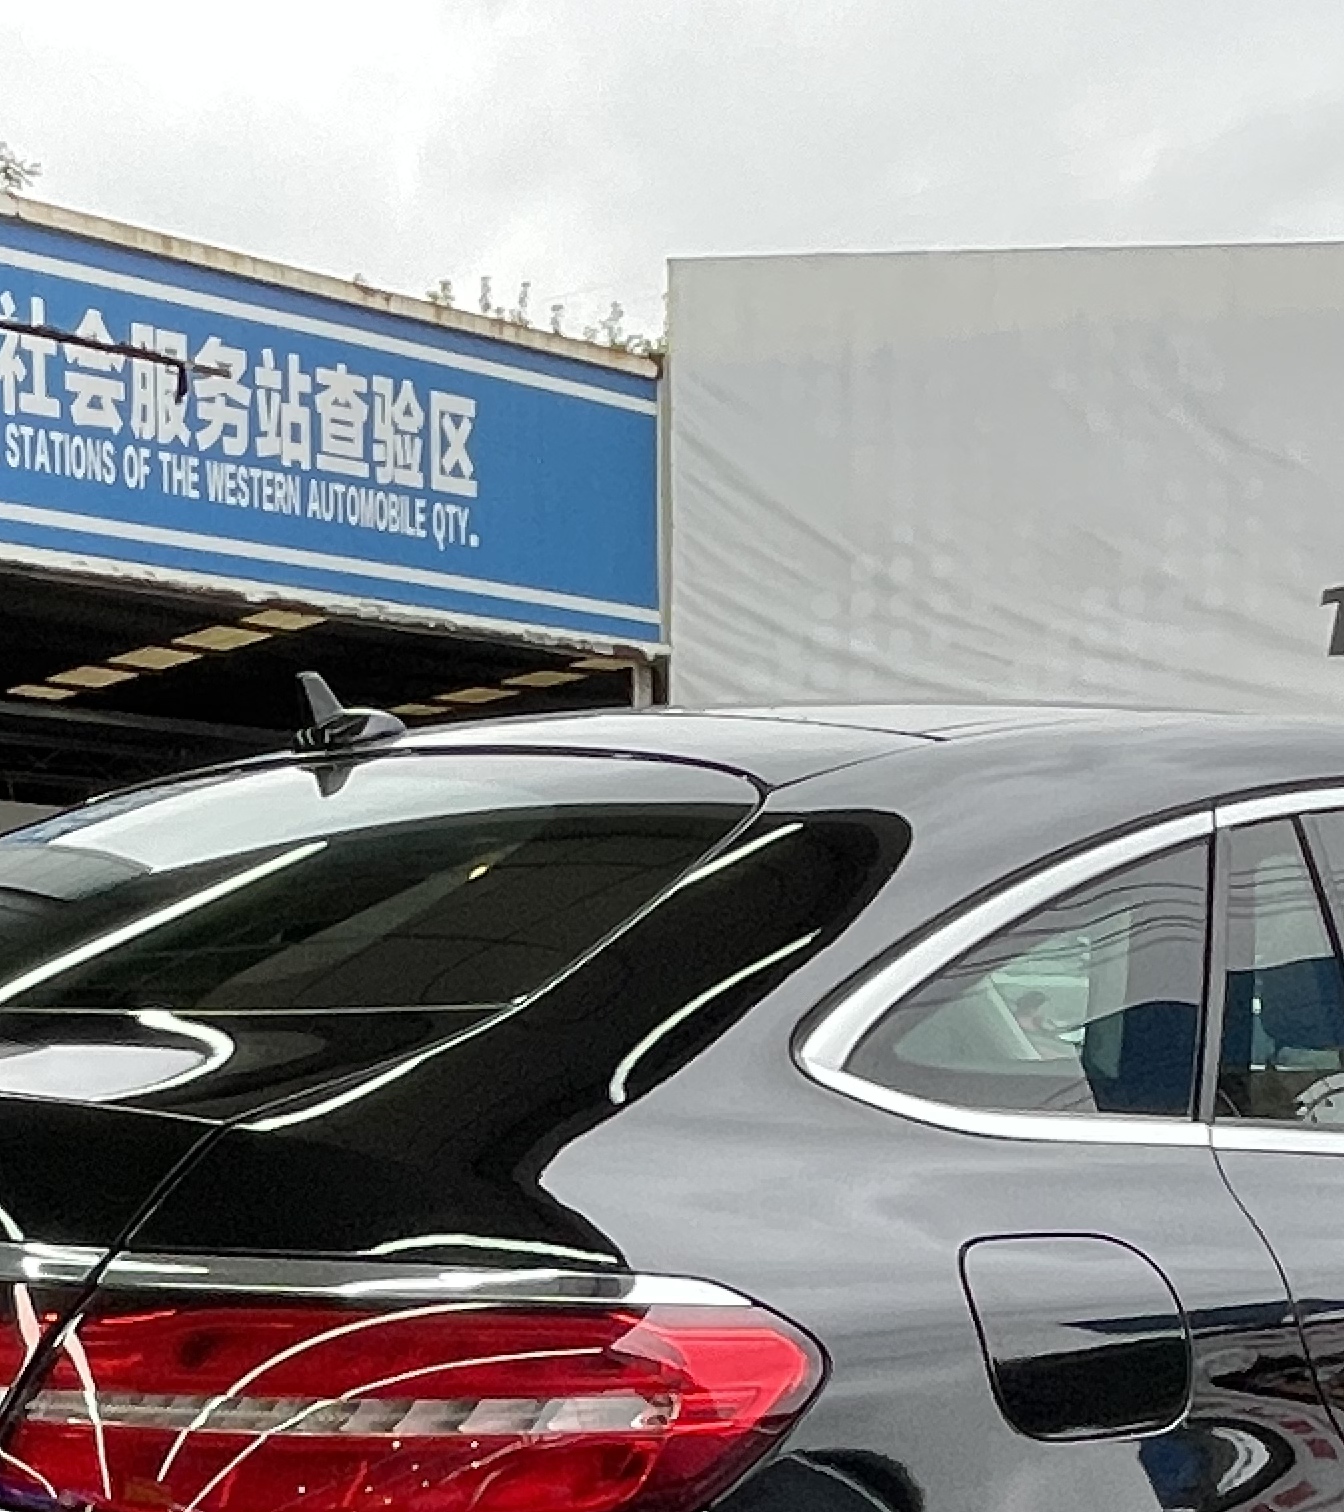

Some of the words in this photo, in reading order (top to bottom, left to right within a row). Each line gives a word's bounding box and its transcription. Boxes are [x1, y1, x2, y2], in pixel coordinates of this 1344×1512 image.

[5, 422, 117, 485] STATIONS
[122, 445, 152, 491] OF
[158, 451, 200, 499] THE
[206, 460, 302, 517] WESTERN
[306, 478, 427, 538] AUTOMOBILE
[432, 501, 479, 551] QTY.
